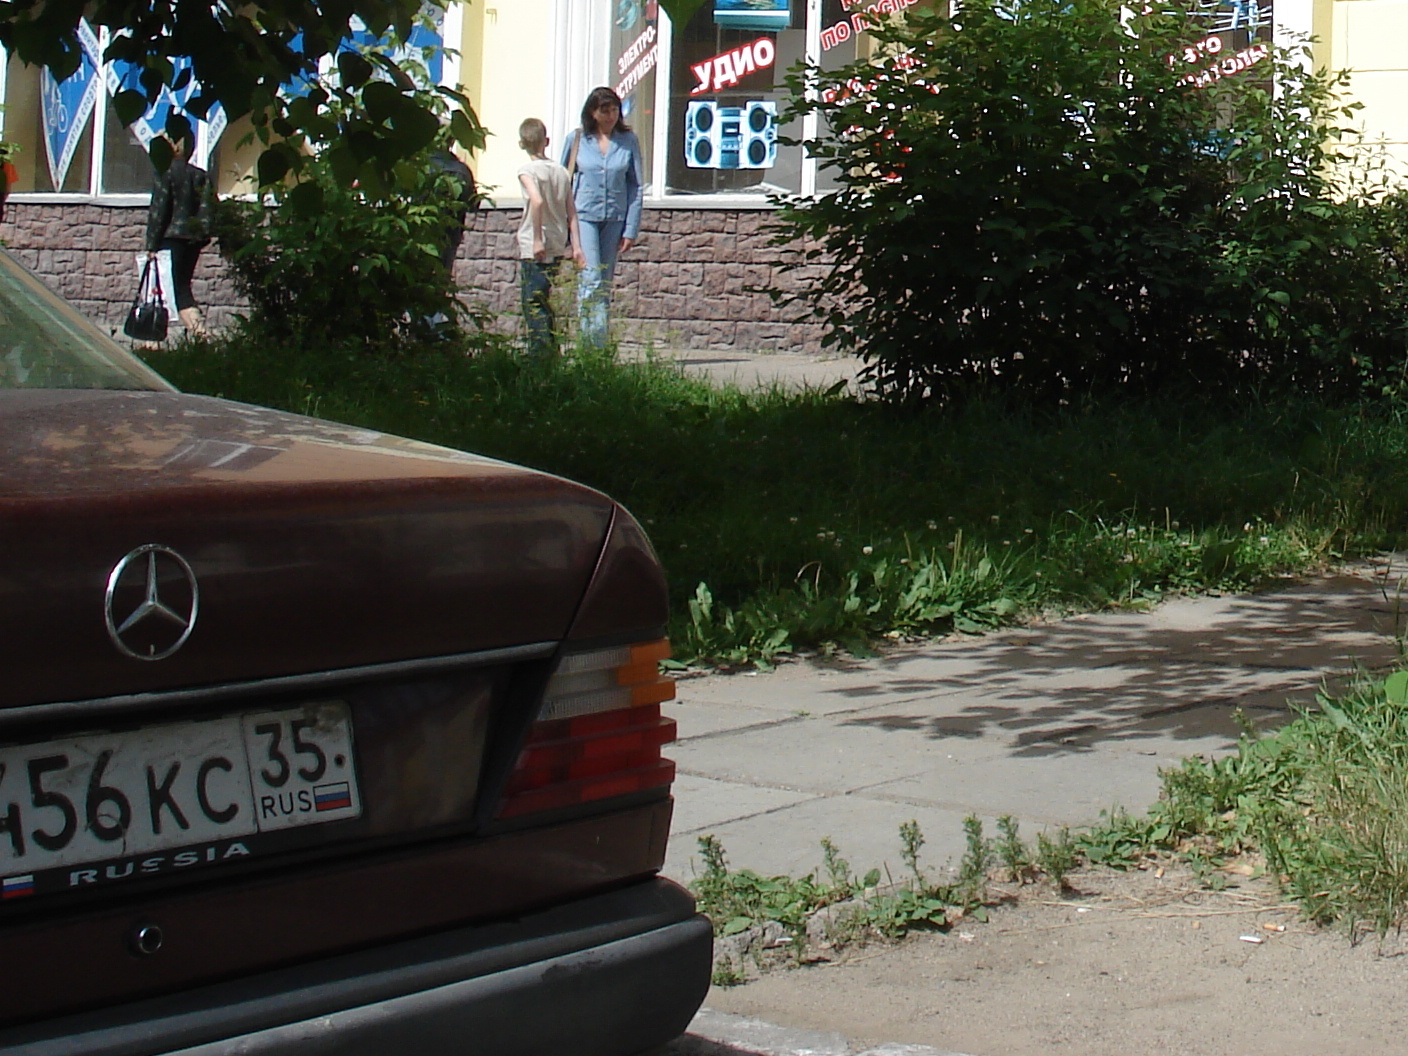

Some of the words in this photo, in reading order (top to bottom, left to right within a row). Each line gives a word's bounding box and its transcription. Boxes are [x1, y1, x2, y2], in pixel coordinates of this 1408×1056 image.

[820, 21, 850, 51] ПО
[261, 789, 313, 819] RUS
[69, 841, 251, 887] RUSSIA
